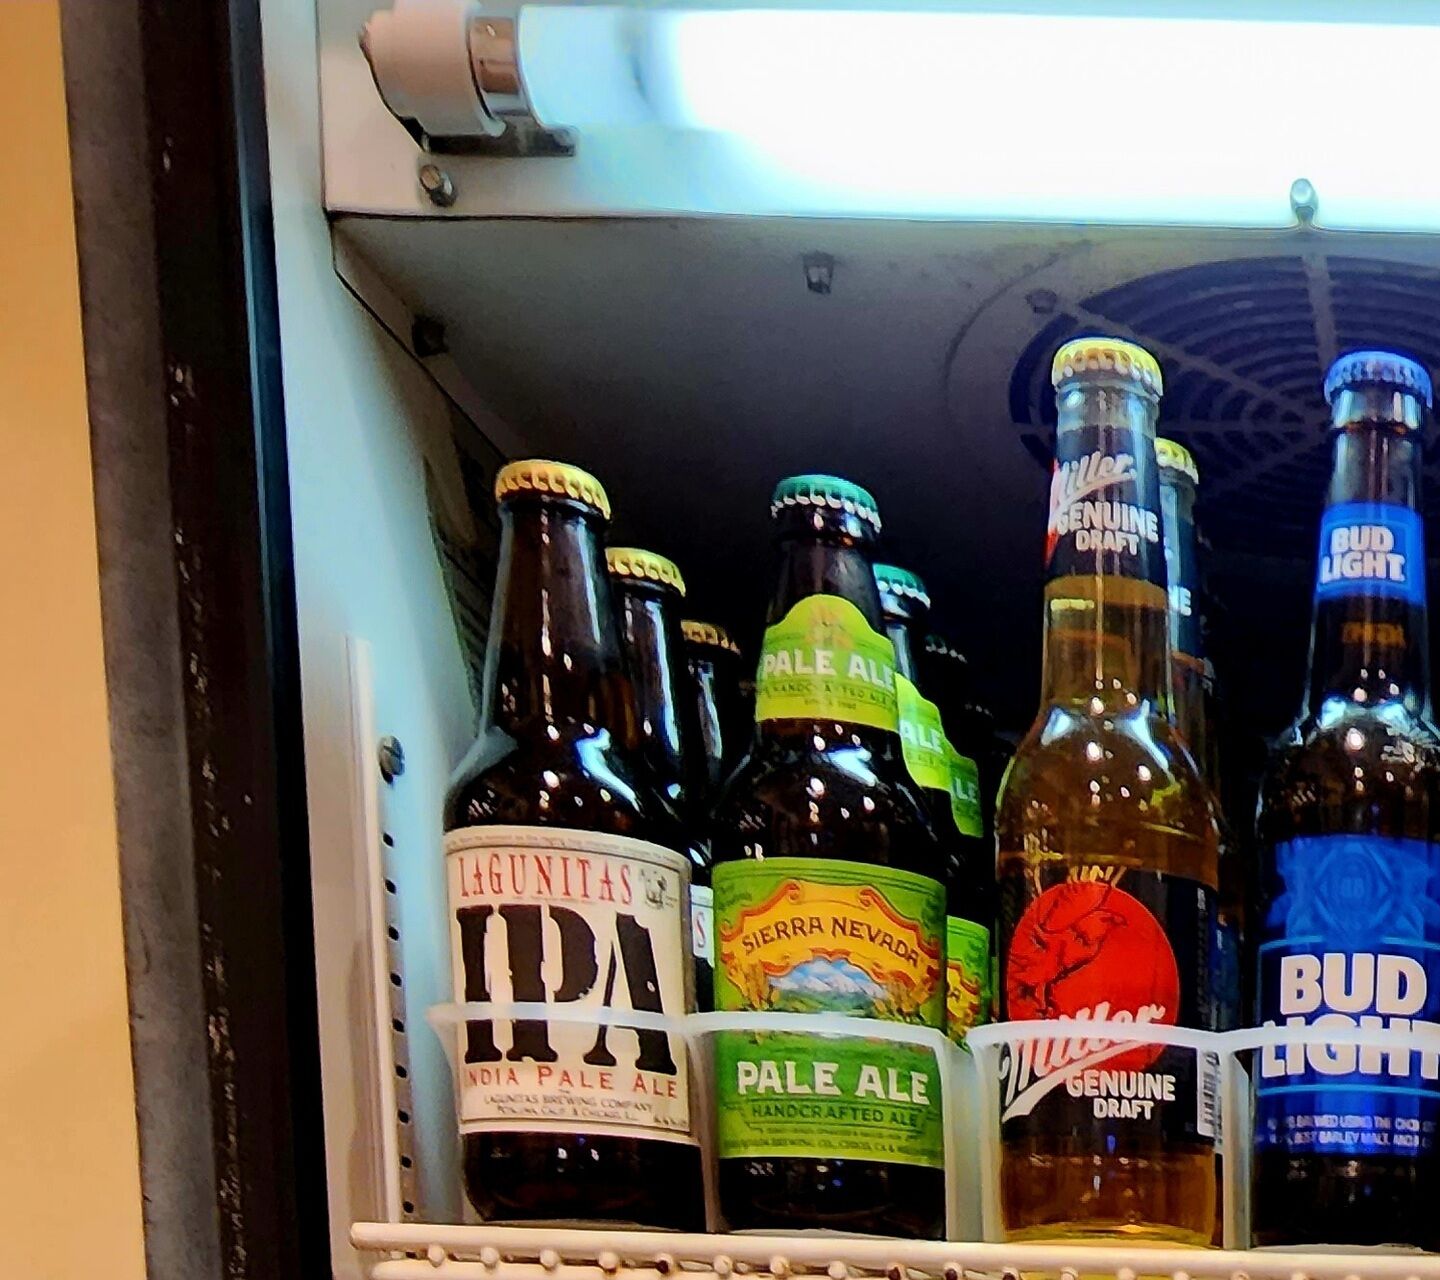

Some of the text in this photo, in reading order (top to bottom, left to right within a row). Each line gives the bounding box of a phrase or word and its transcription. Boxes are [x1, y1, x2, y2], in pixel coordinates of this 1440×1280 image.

[1051, 451, 1137, 502] Miller
[1056, 500, 1158, 543] GENUINE
[1331, 525, 1395, 554] BUD
[1076, 530, 1139, 555] DRAFT
[1320, 550, 1406, 584] LIGHT
[763, 648, 896, 694] PALE ALE
[899, 720, 944, 755] ALE
[458, 852, 632, 905] LAGUNITAS
[741, 916, 825, 956] SIERRA
[830, 916, 921, 968] NEVADA
[455, 903, 678, 1076] IPA
[1280, 952, 1427, 1015] BUD
[536, 1064, 678, 1098] PALE ALE
[736, 1060, 930, 1106] PALE ALE
[1066, 1070, 1176, 1101] GENUINE
[751, 1103, 920, 1128] HANDCRAFTED ALE
[1093, 1098, 1154, 1119] DRAFT
